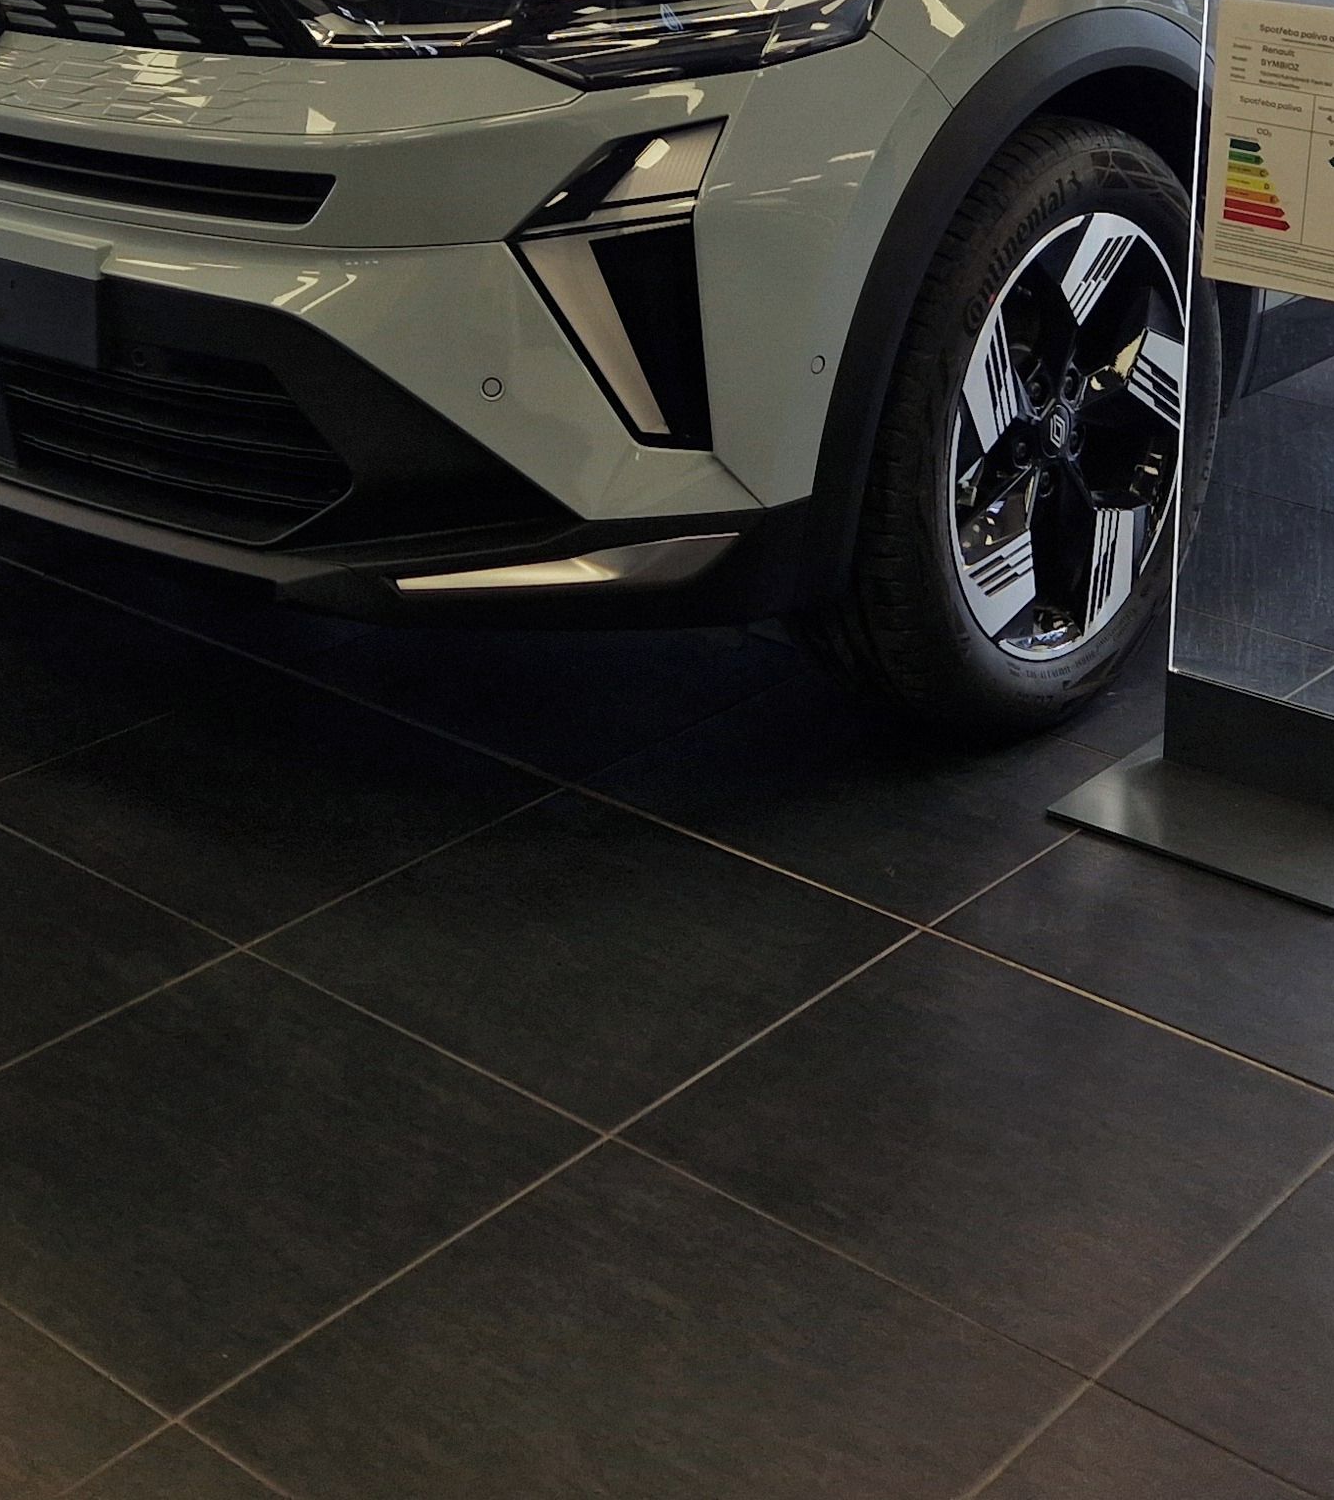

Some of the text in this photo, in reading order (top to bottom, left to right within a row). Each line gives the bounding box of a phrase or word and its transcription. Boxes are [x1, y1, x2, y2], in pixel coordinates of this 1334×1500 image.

[1259, 24, 1300, 38] Spotřeba
[1300, 30, 1328, 42] paliva
[1329, 35, 1334, 43] a
[1262, 45, 1295, 57] Renault
[1261, 58, 1299, 72] SYMBIOZ
[1239, 95, 1303, 113] Spotřeba paliva
[962, 177, 1067, 338] Continental
